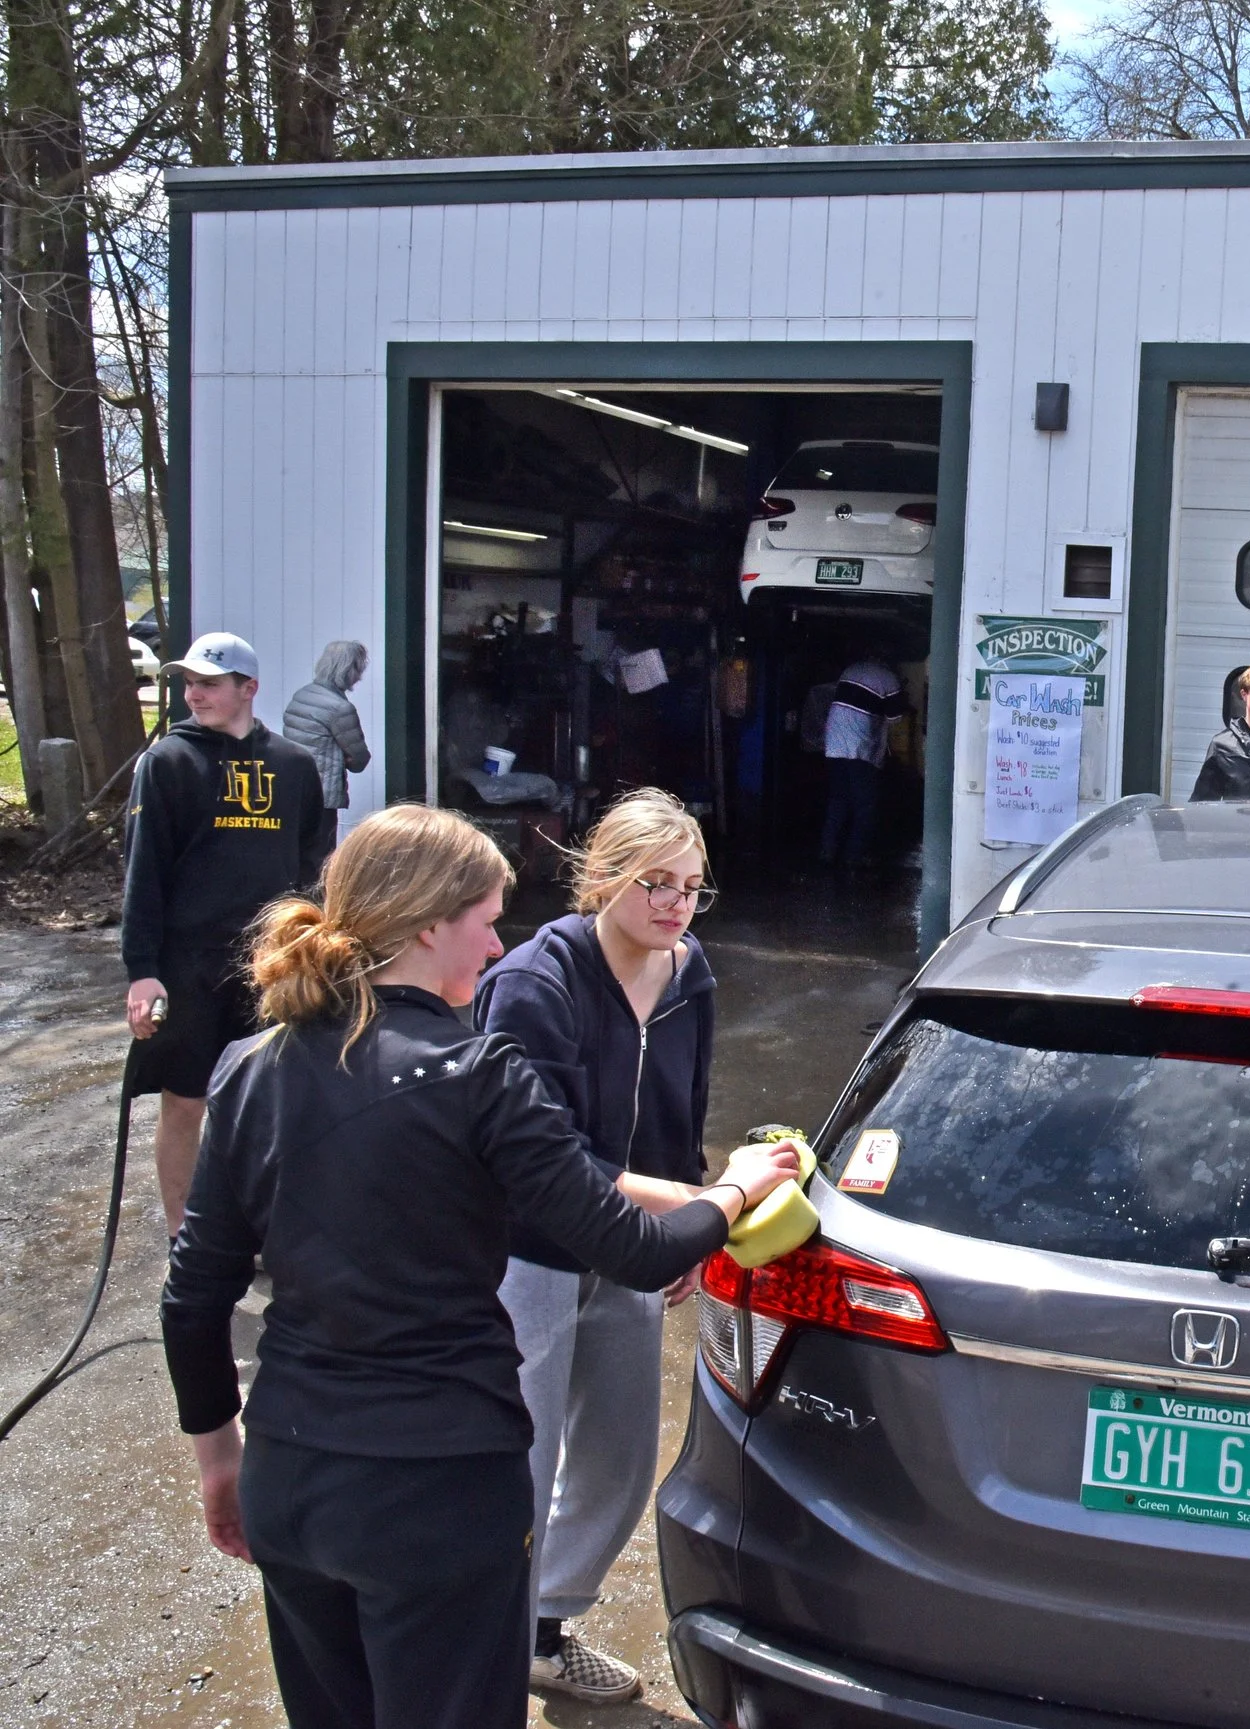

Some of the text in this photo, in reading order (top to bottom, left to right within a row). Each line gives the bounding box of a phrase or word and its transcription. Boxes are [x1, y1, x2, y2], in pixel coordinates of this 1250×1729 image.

[841, 566, 858, 578] 293
[987, 629, 1098, 666] INSPECTION
[995, 680, 1028, 709] Car
[1029, 682, 1082, 717] Wash
[1012, 710, 1058, 731] Prices
[849, 1180, 875, 1188] FAMILY
[1104, 1422, 1188, 1488] GYH
[1138, 1498, 1170, 1512] Green
[1178, 1503, 1229, 1520] Mountain
